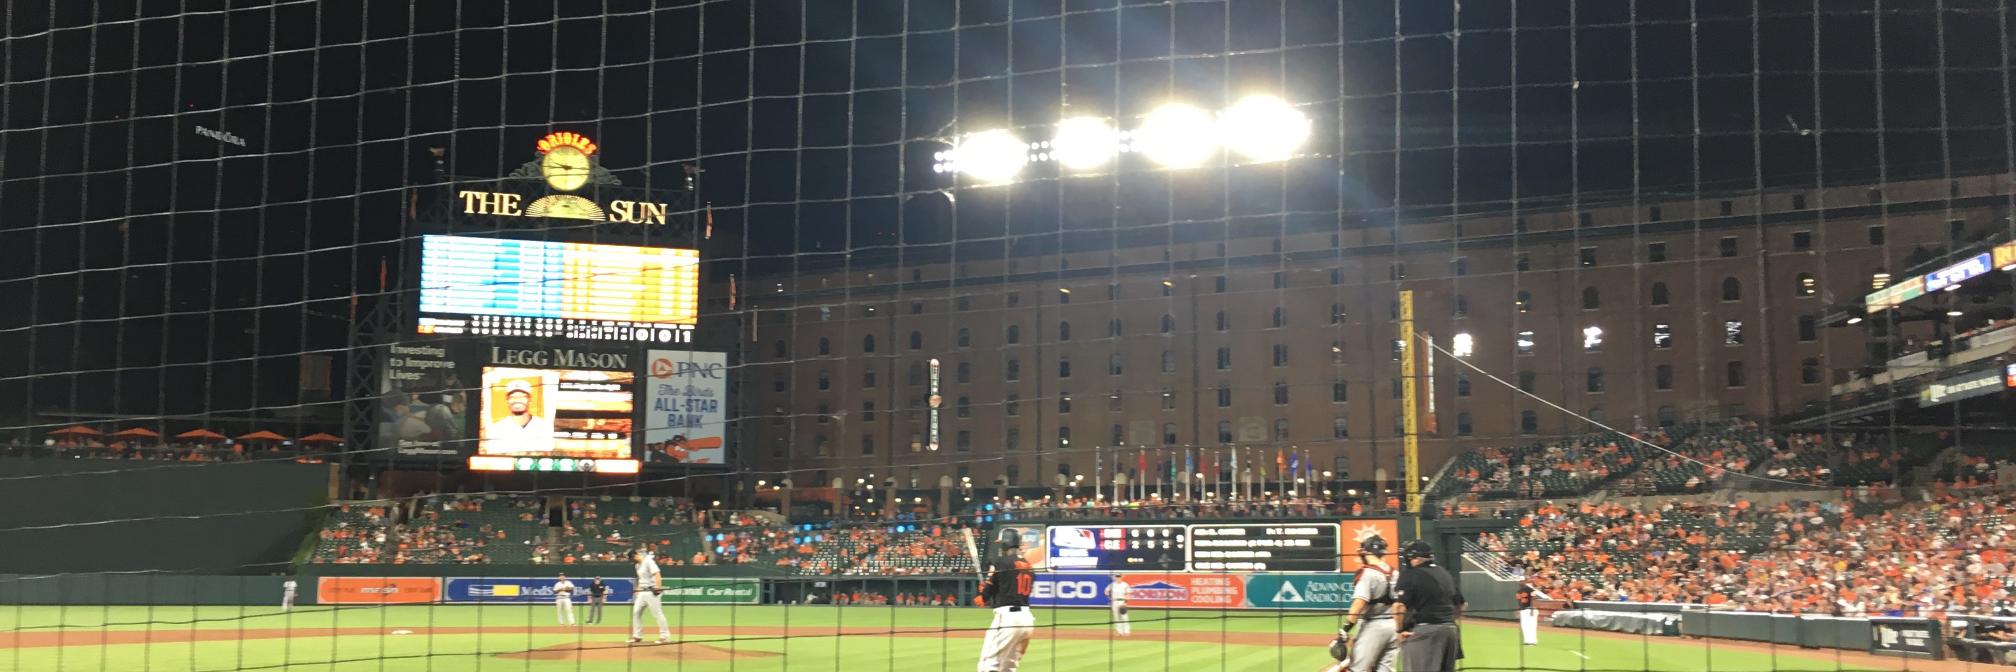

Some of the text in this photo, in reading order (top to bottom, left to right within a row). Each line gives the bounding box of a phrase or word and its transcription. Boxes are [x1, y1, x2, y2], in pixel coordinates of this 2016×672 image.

[195, 125, 247, 147] PANDORA
[537, 132, 597, 155] ORIOLES
[459, 190, 668, 225] THE SUN
[390, 344, 445, 358] Investing
[491, 346, 628, 369] LEGG MASON
[390, 357, 456, 369] to Improve
[676, 361, 723, 379] PNC
[658, 383, 714, 397] The Birds
[654, 398, 718, 413] ALL-STAR
[668, 413, 704, 429] BANK
[1016, 573, 1033, 596] 10
[1191, 577, 1231, 586] HEATING
[1307, 580, 1355, 592] ADVANCE
[520, 585, 556, 597] MedS
[706, 587, 723, 596] Car
[723, 587, 753, 596] Rental
[1030, 580, 1098, 599] EICO
[1191, 586, 1239, 595] PLUMBING
[1191, 595, 1232, 603] COOLING
[1304, 591, 1352, 603] RADIOLO
